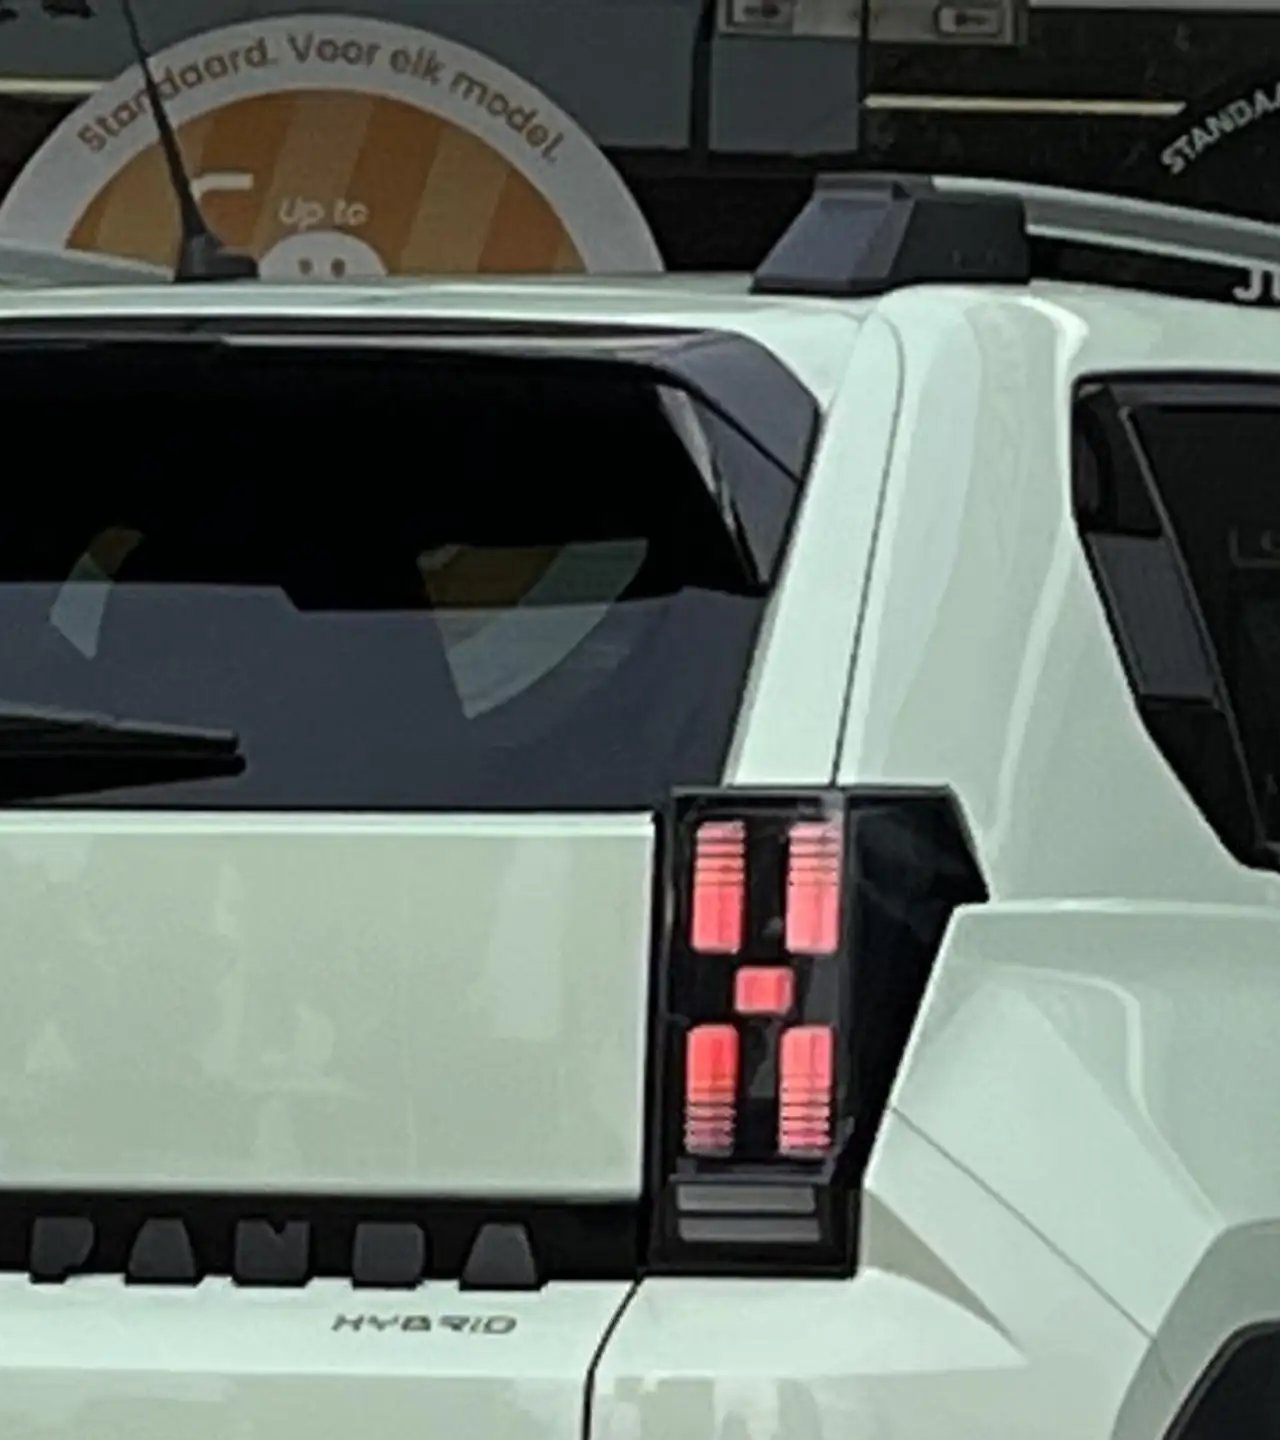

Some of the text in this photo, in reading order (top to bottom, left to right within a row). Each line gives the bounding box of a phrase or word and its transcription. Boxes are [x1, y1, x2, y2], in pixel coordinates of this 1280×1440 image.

[287, 32, 381, 67] Voor
[390, 47, 445, 86] elk
[29, 1216, 542, 1291] PANDA
[331, 1313, 517, 1335] HYBRID
